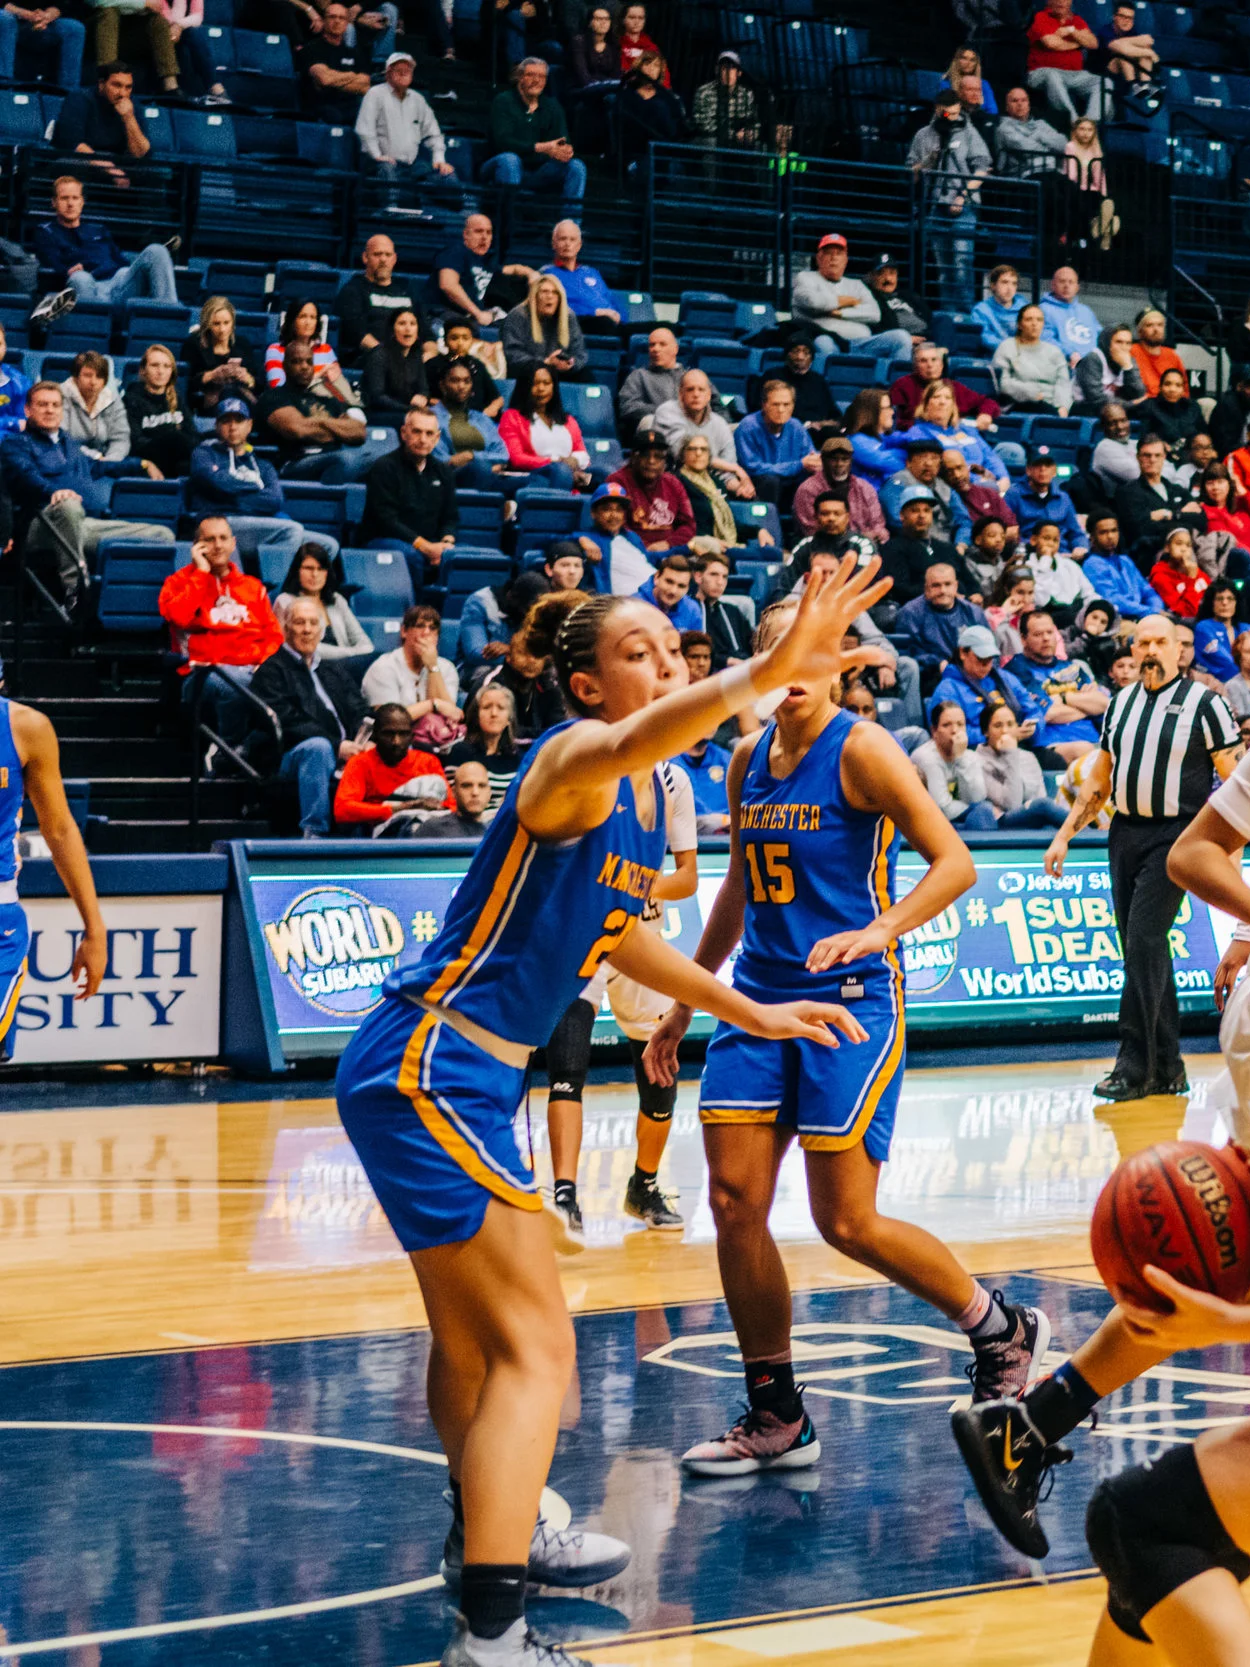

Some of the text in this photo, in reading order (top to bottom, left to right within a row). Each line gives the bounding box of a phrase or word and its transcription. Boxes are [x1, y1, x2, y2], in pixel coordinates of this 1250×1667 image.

[746, 843, 796, 904] 15
[264, 904, 405, 974] WORLD
[1032, 929, 1191, 964] DEAR
[302, 962, 391, 997] SUBARU
[1180, 1154, 1239, 1271] Wilson
